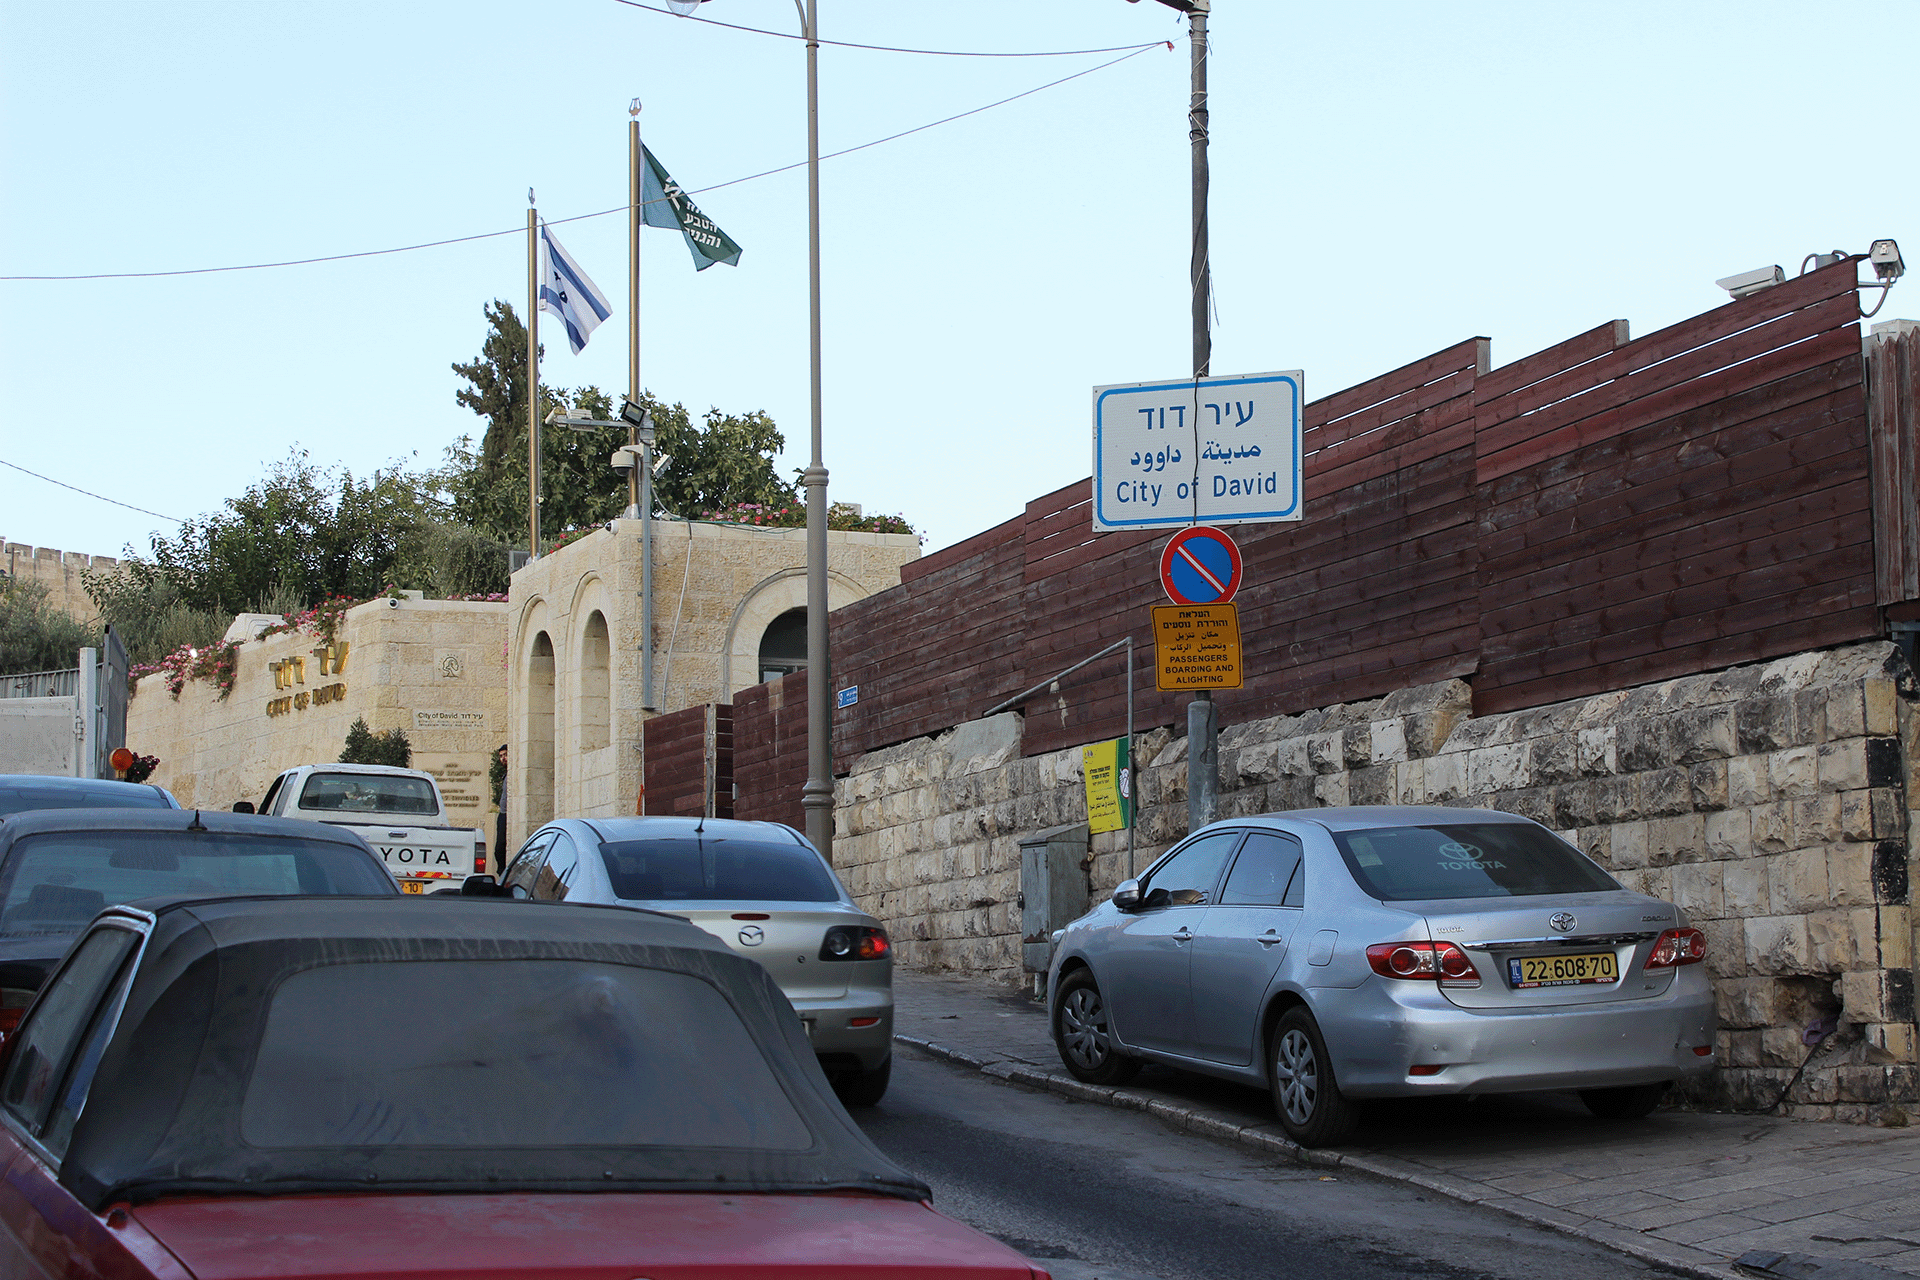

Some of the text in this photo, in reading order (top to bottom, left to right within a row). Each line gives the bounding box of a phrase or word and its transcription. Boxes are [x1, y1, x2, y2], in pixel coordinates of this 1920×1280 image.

[684, 213, 718, 233] הטבע
[1138, 400, 1254, 430] עיר דוד
[1130, 441, 1262, 473] مدينة داوود
[1116, 471, 1277, 507] City of David
[1196, 619, 1229, 628] והורדת
[269, 641, 350, 691] עיר דוד
[1169, 654, 1228, 664] PASSENGERS
[1165, 664, 1234, 674] BOARDING AND
[1175, 675, 1224, 684] ALIGHTING
[418, 711, 431, 720] City
[380, 847, 450, 865] YOTA
[1437, 860, 1507, 870] TOYOTA
